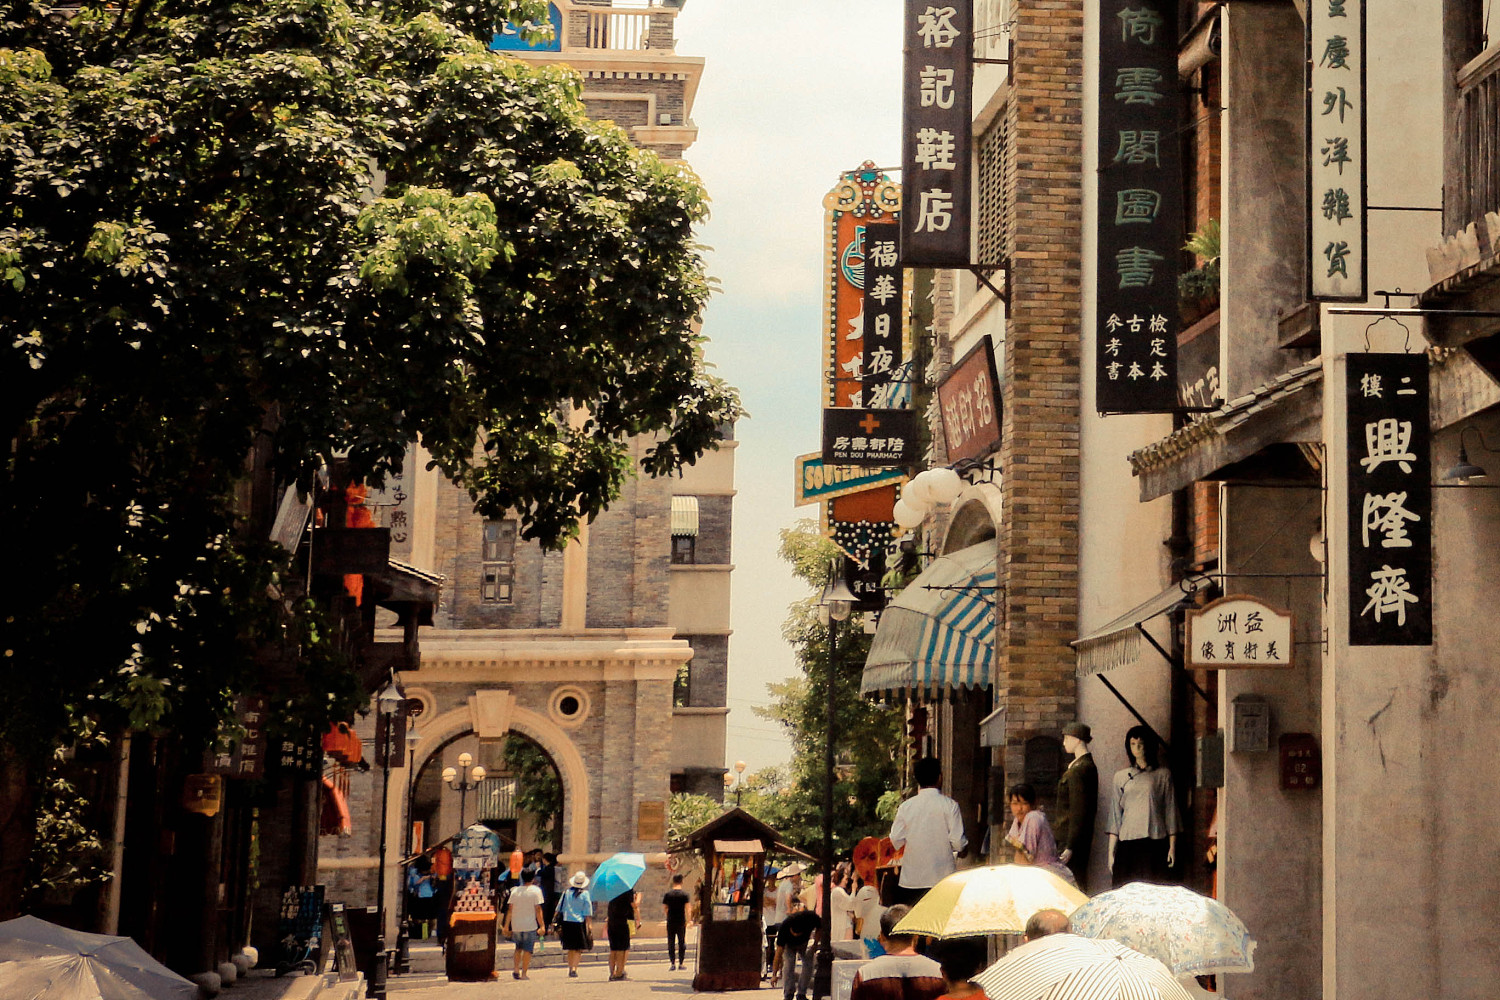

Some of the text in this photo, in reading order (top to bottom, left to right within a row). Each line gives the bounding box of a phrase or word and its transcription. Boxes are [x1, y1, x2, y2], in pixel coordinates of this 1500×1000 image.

[1114, 5, 1166, 289] 倚雲閣圖書
[1105, 313, 1123, 382] 參考書
[1127, 313, 1145, 382] 古本
[1149, 313, 1168, 382] 檢定本
[1359, 372, 1417, 398] 二樓
